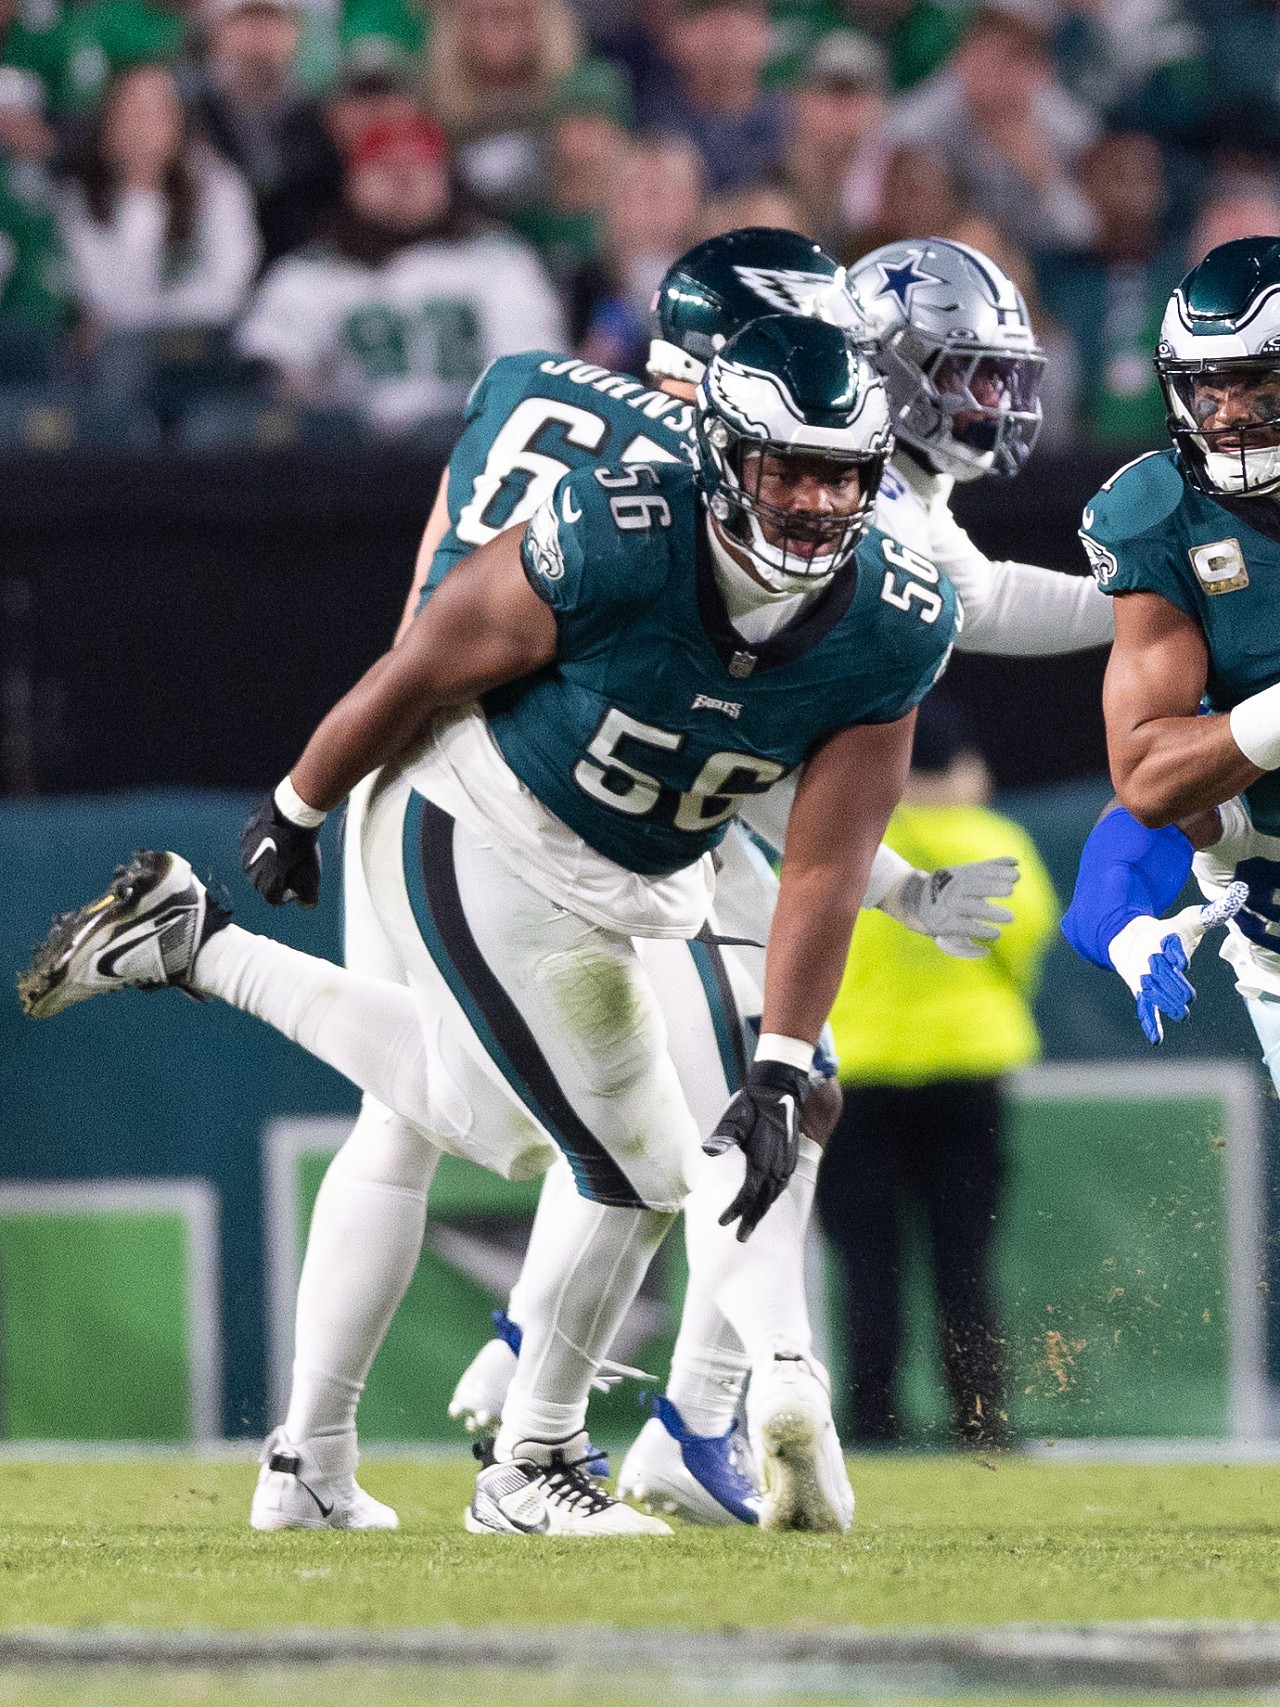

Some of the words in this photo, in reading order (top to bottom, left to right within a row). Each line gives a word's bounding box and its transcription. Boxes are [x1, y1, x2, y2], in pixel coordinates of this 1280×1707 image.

[540, 359, 697, 441] JOHNS
[456, 397, 683, 545] 6
[594, 464, 672, 529] 56
[881, 538, 942, 624] 56
[1194, 543, 1240, 582] C
[574, 708, 785, 831] 56
